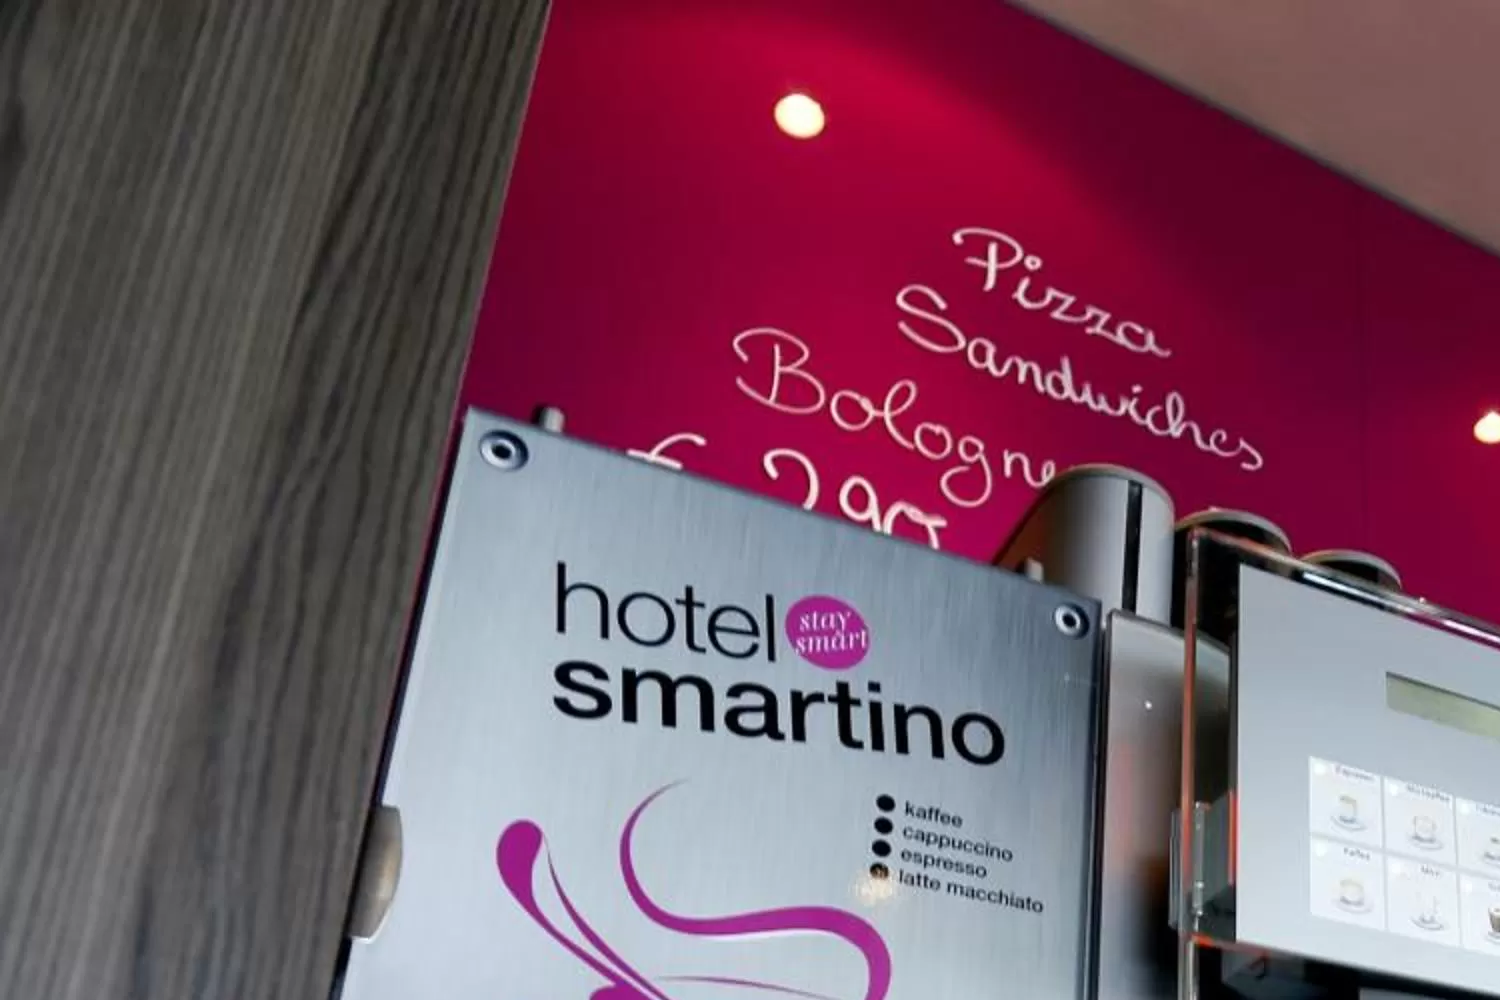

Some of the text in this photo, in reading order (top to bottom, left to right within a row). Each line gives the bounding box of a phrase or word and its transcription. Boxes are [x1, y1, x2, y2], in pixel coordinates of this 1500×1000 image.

[952, 228, 1171, 357] Pizza
[896, 284, 1264, 470] Sandwiches
[555, 561, 776, 662] hotel
[799, 610, 851, 636] stay
[795, 629, 867, 656] smart
[552, 660, 1006, 766] smartino
[905, 801, 963, 829] kaffee
[901, 849, 987, 879] espresso
[903, 826, 1014, 863] cappuccino
[899, 870, 1044, 914] latte macchiato
